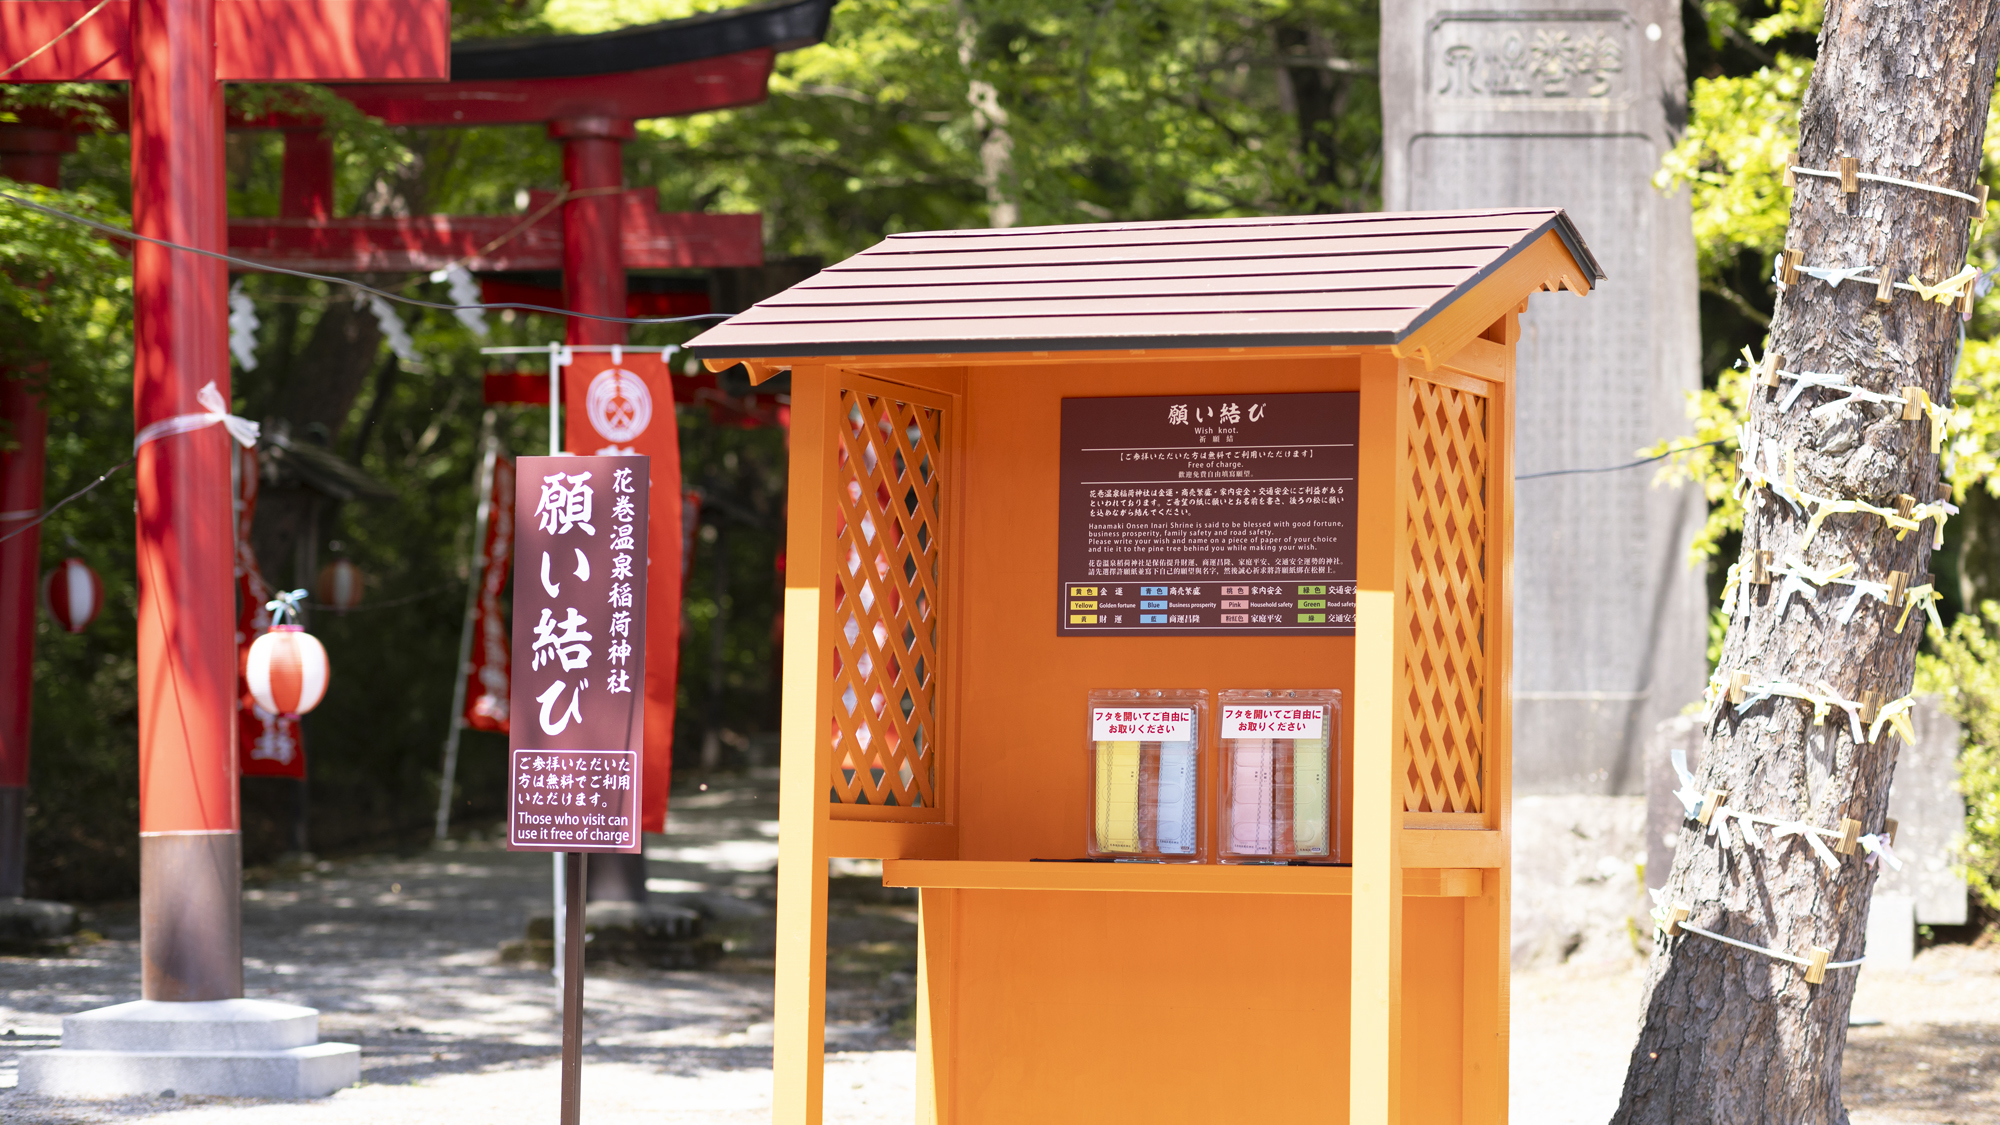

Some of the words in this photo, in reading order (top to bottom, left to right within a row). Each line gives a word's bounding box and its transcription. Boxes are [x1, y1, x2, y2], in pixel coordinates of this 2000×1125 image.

[1167, 402, 1266, 426] 願い結び
[1216, 461, 1244, 469] charge.
[1228, 537, 1248, 545] piece
[607, 467, 636, 694] 花巻温泉稲荷神社
[532, 471, 596, 736] 願い結び
[1096, 711, 1189, 722] フタを開いてご自由に
[1225, 710, 1321, 720] フタを開いてご自由に
[1109, 724, 1175, 734] お取りください
[1238, 722, 1306, 731] お取りください
[519, 756, 630, 772] ご参拝いただいた
[518, 773, 630, 790] 方は無料でご利用
[518, 792, 608, 808] いただけます。
[518, 812, 552, 825] Those
[554, 812, 580, 825] who
[582, 813, 605, 826] visit
[608, 816, 628, 826] can
[518, 829, 538, 839] use
[540, 828, 548, 840] it
[550, 827, 573, 840] free
[576, 828, 588, 840] of
[590, 828, 630, 844] charge
